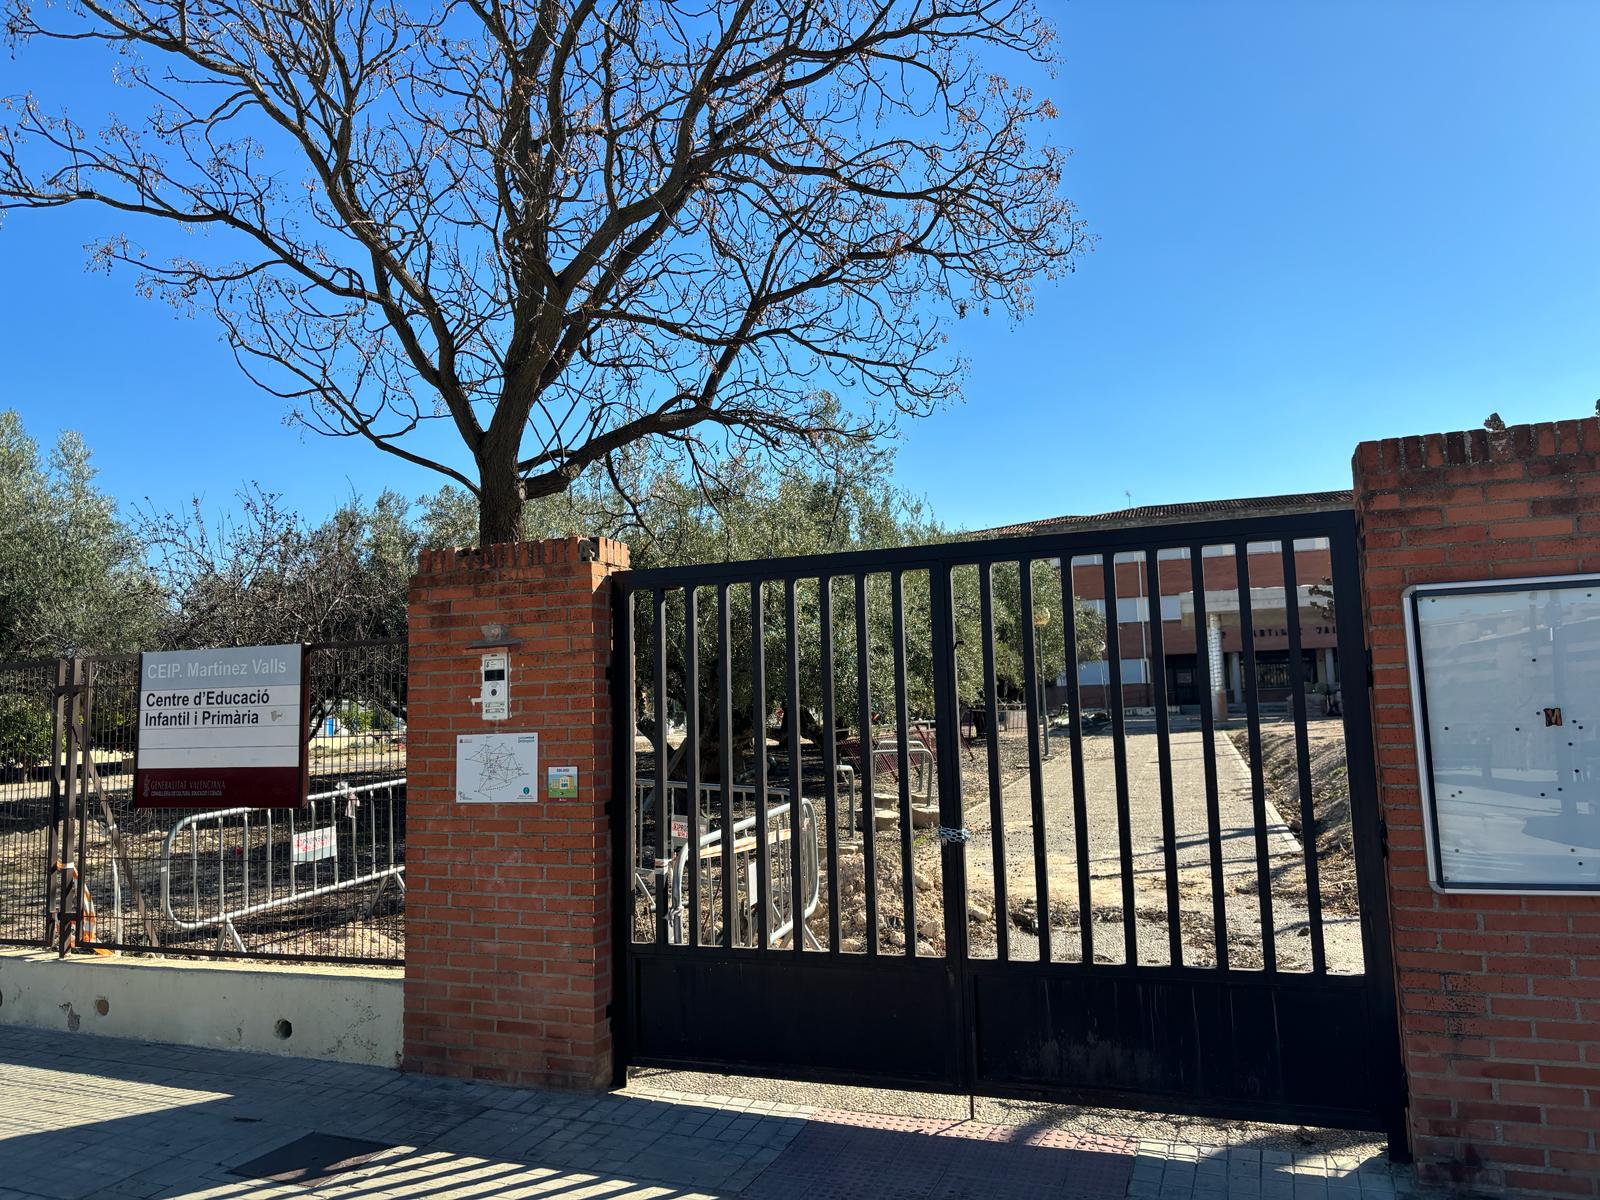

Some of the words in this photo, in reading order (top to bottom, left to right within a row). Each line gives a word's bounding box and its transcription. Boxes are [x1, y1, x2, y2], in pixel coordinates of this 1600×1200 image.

[147, 663, 182, 679] CEIP.
[252, 658, 286, 674] Valls
[146, 692, 189, 707] Centre
[145, 711, 190, 727] Infantil
[194, 711, 198, 726] i
[202, 710, 259, 726] Primària
[150, 780, 187, 790] GENERALITAT
[189, 780, 226, 790] VALENCIANA
